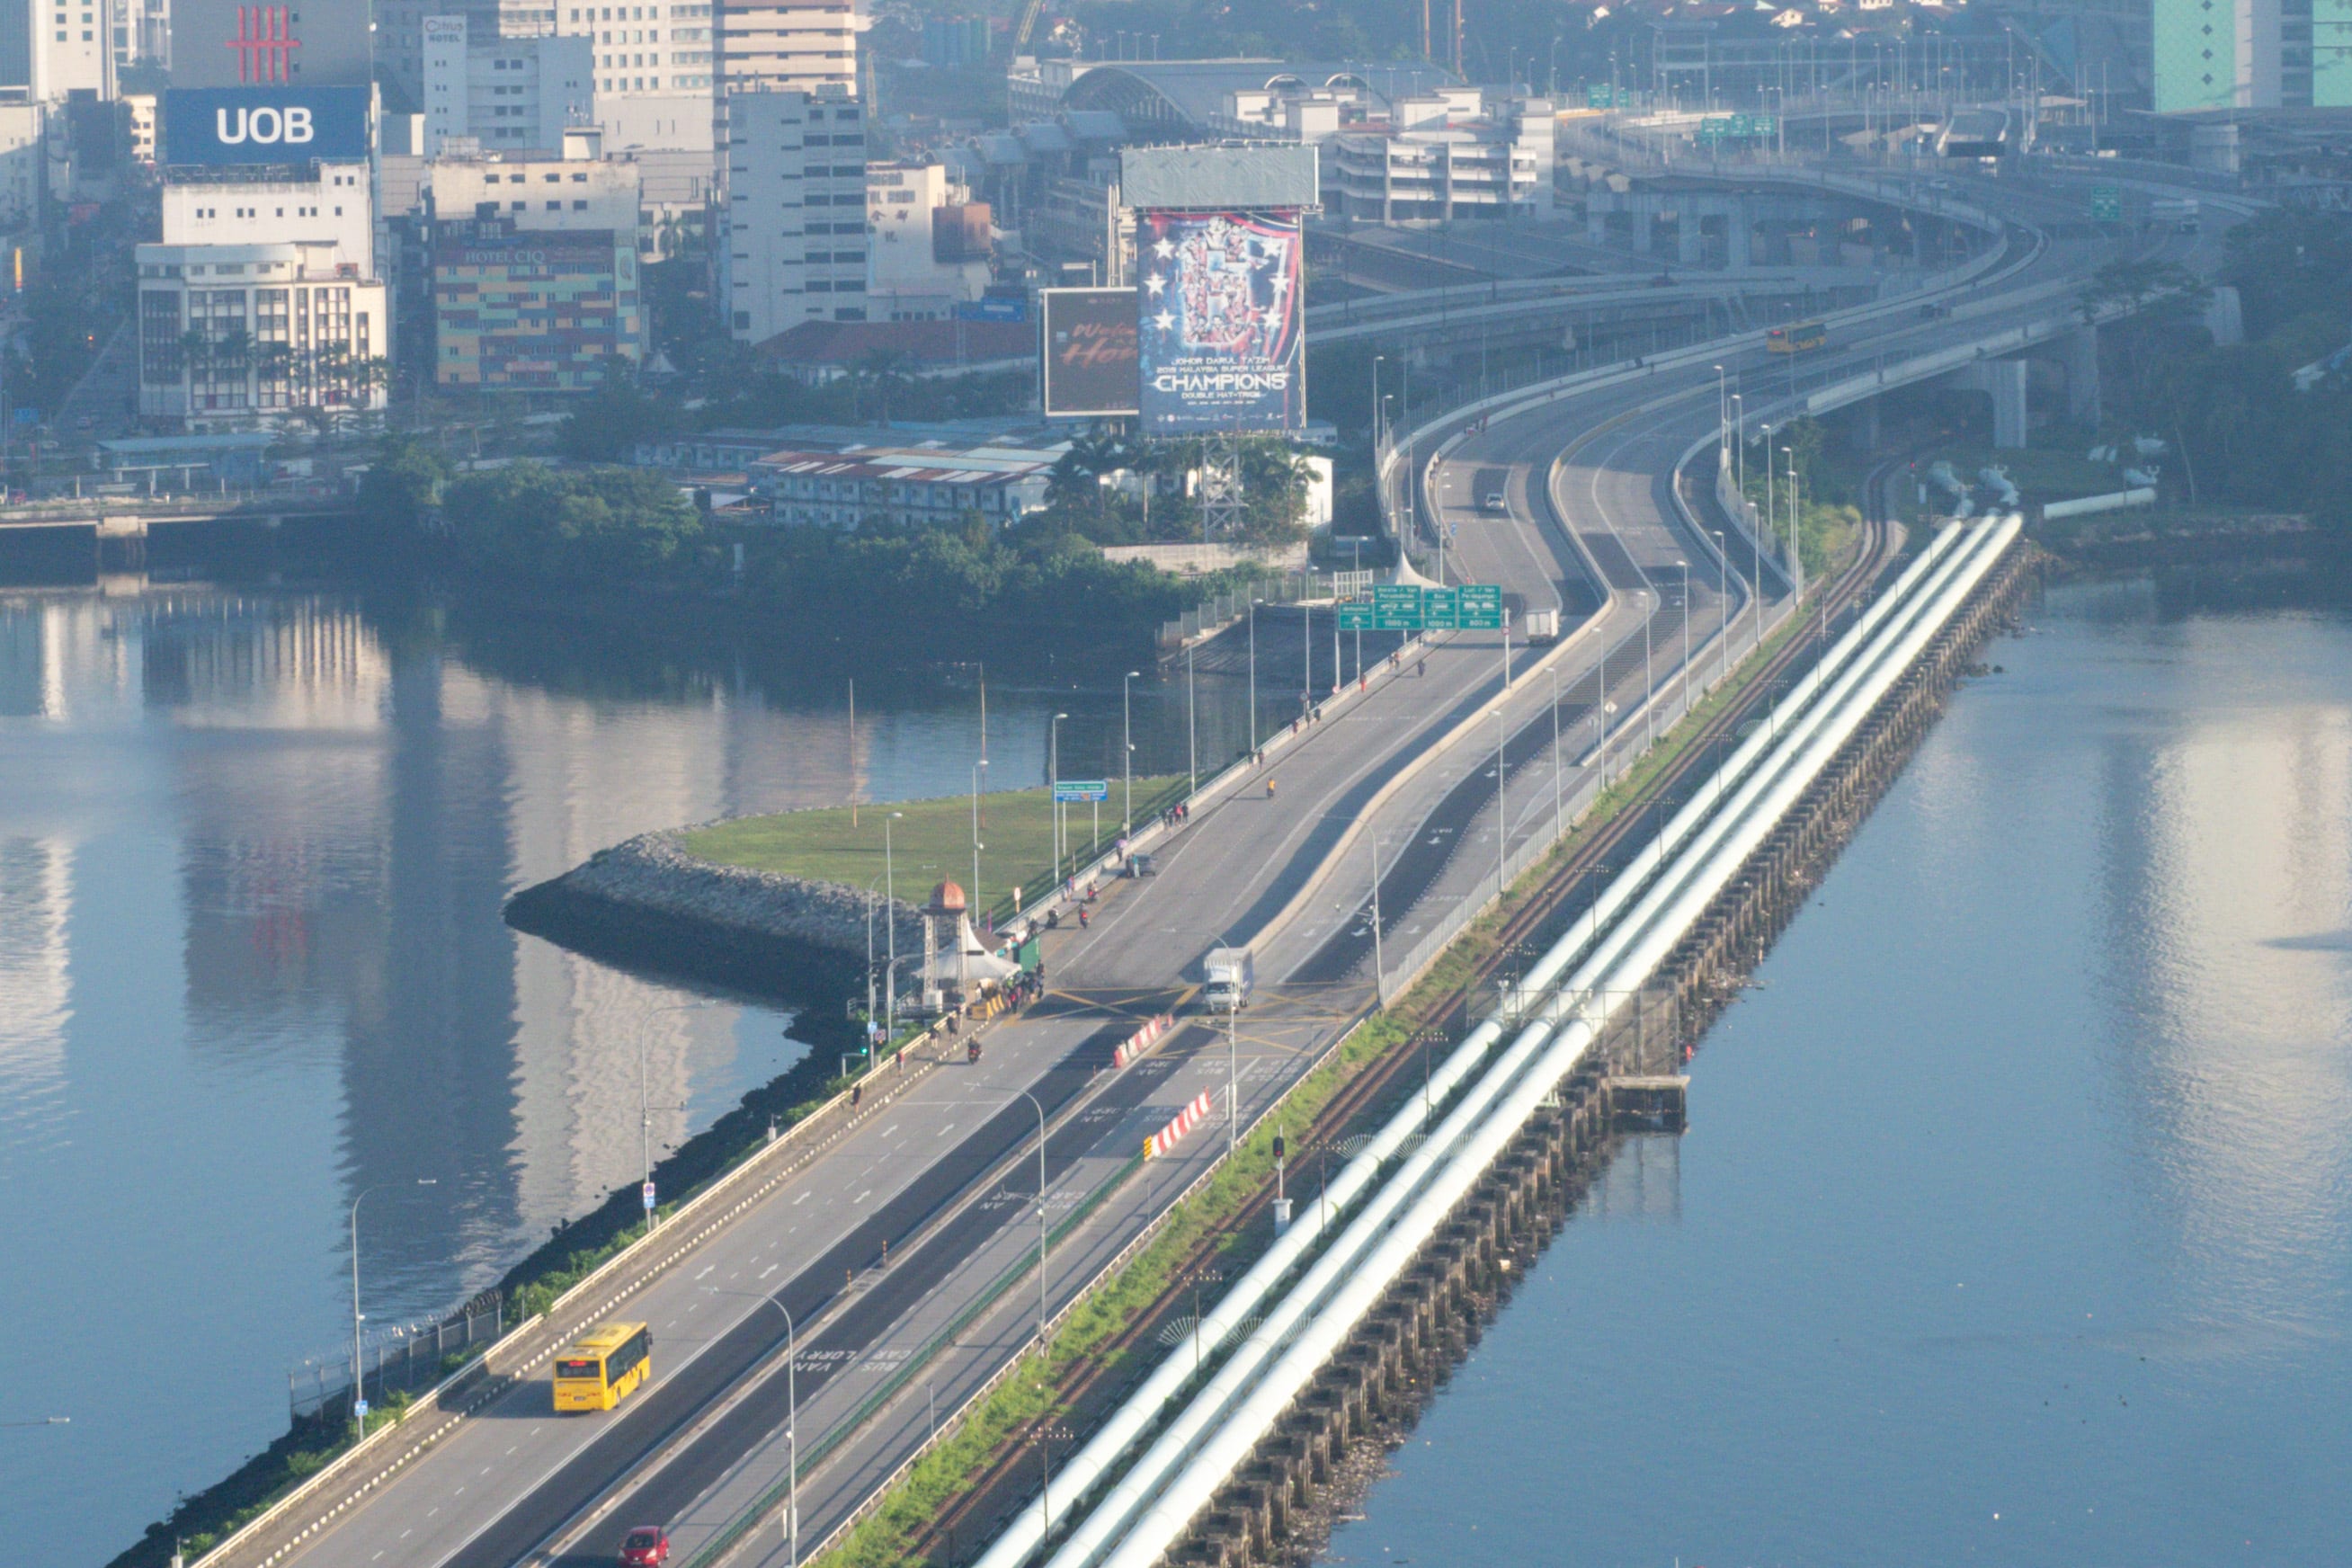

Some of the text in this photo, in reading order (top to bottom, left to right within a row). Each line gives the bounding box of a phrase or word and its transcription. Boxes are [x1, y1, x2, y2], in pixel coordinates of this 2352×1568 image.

[217, 107, 314, 144] UOB
[465, 251, 512, 263] HOTEL
[515, 250, 545, 264] CIQ
[1171, 358, 1203, 366] JOHOR
[1206, 357, 1237, 365] DARUL
[1154, 373, 1288, 392] CHAMPIONS
[795, 1350, 857, 1360] LORRY
[871, 1350, 912, 1360] CAR
[794, 1361, 832, 1372] VAN
[862, 1361, 900, 1372] BUS
